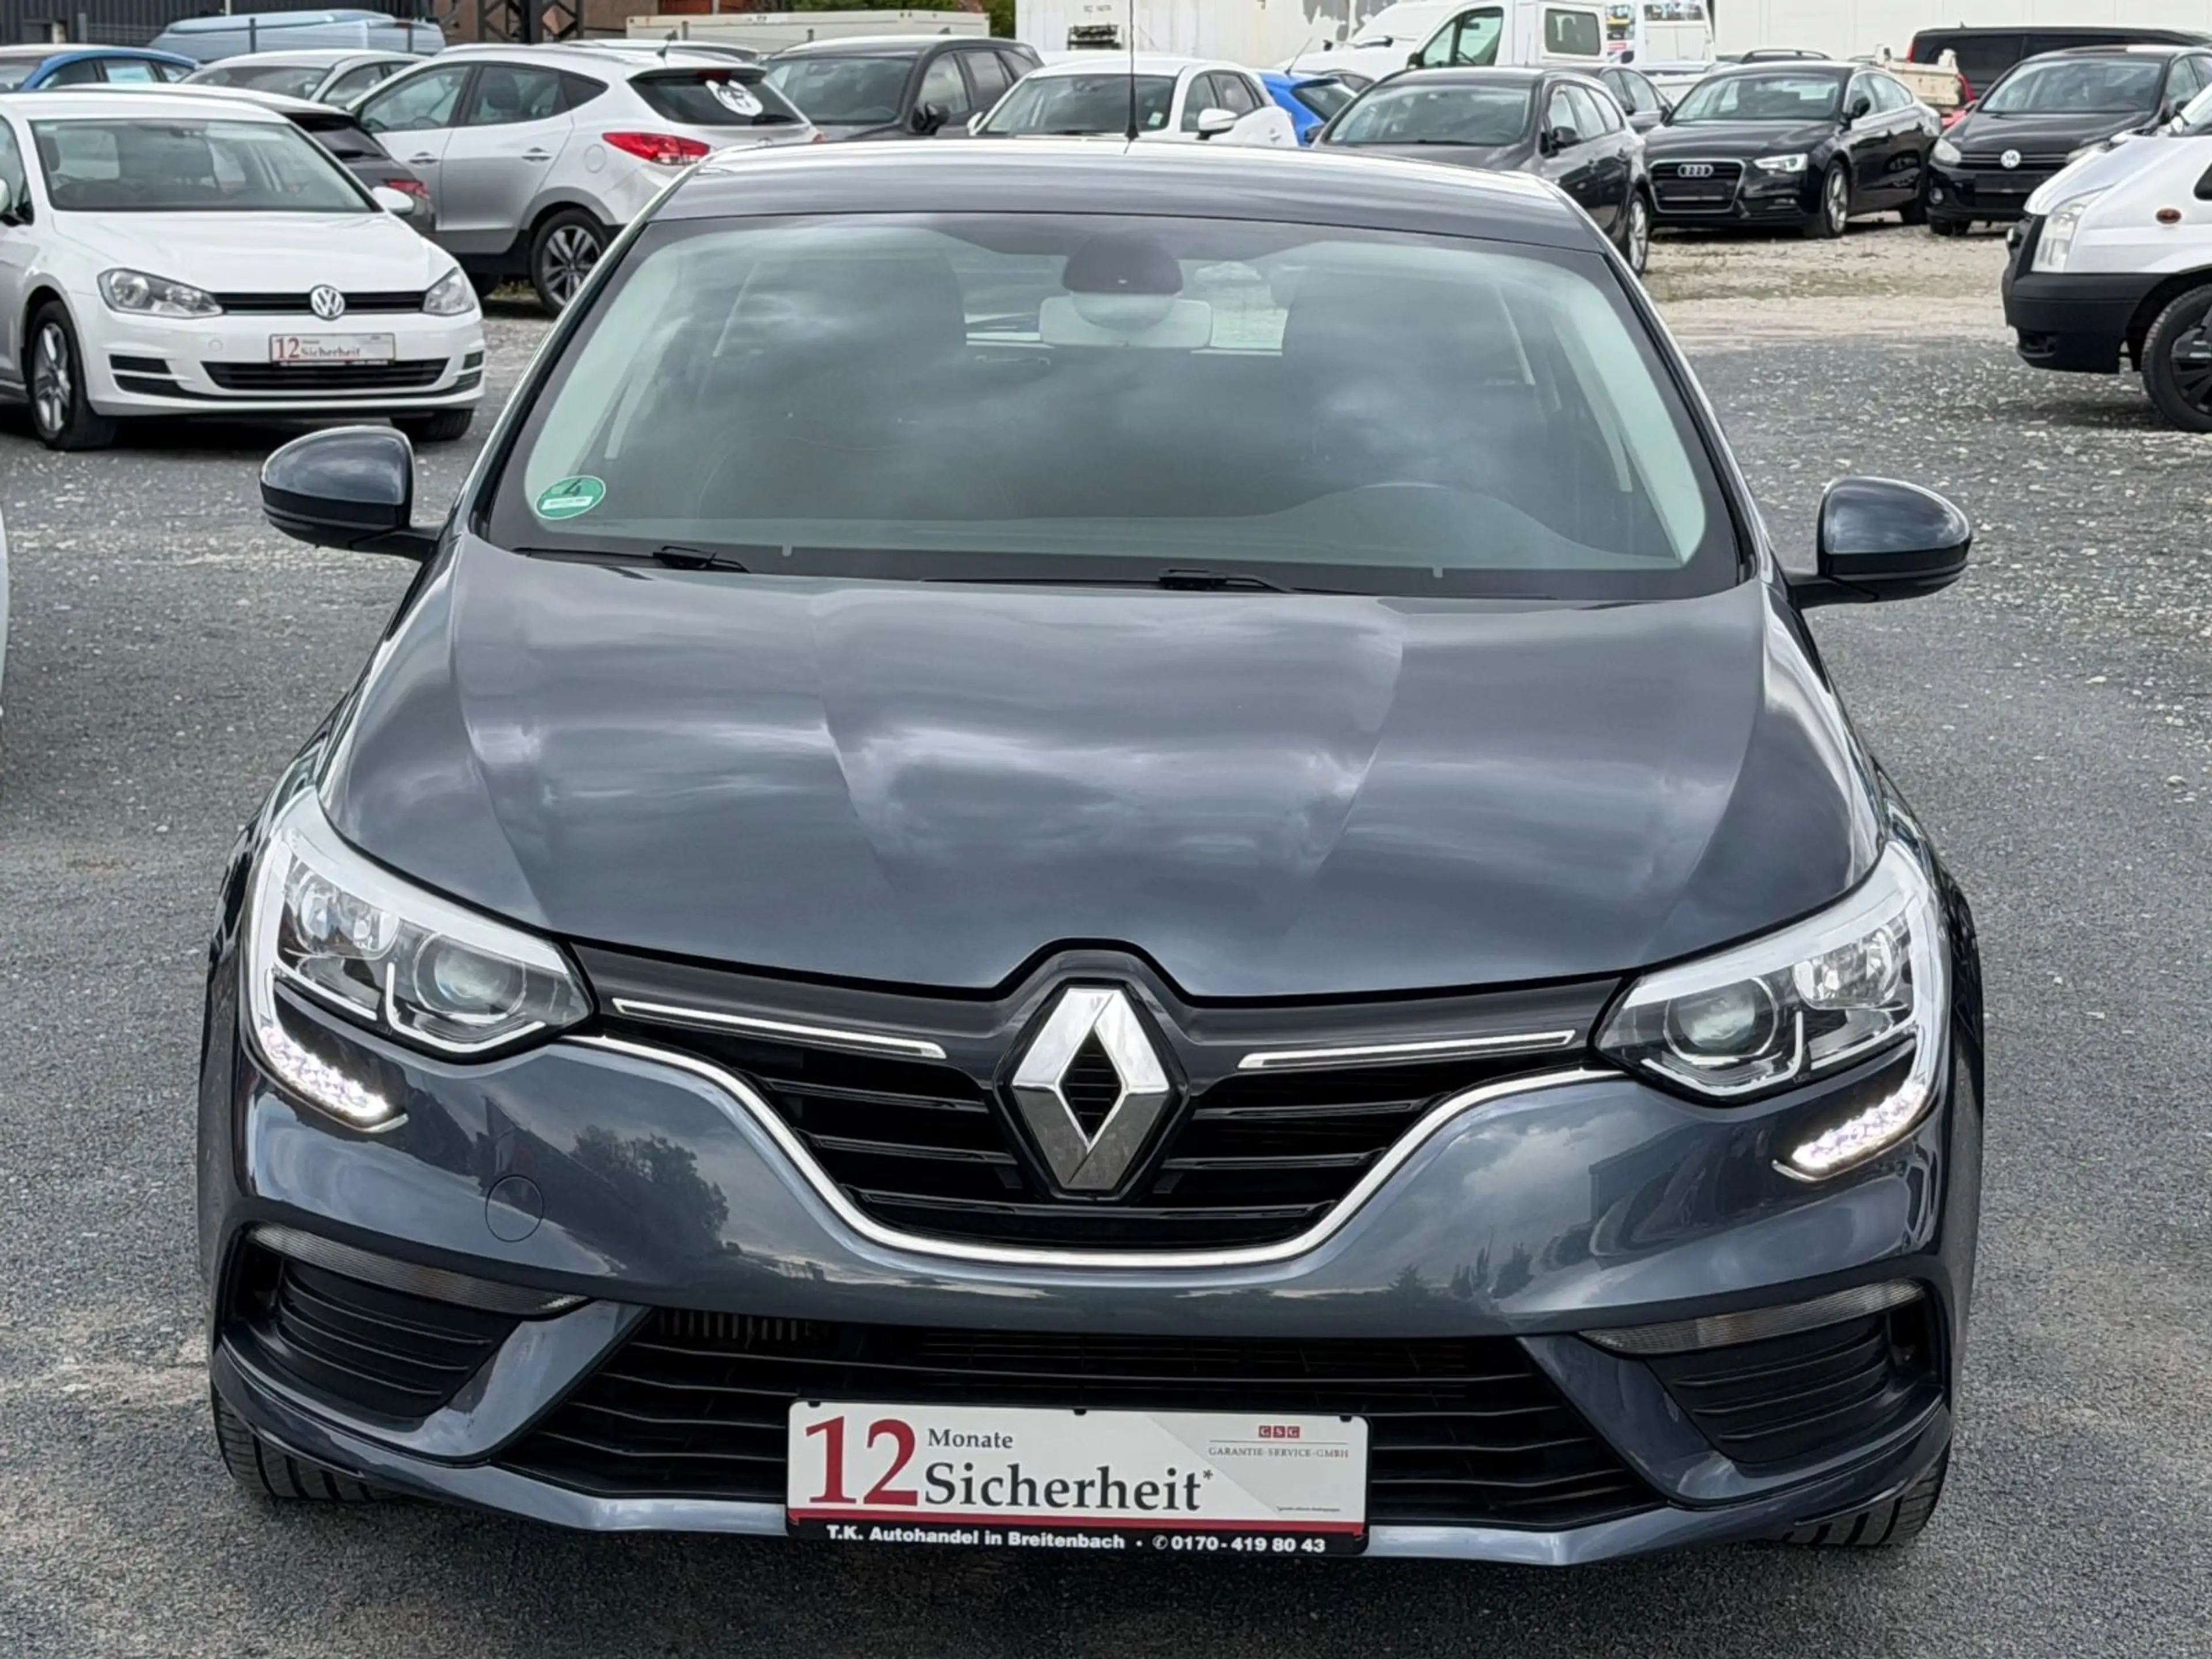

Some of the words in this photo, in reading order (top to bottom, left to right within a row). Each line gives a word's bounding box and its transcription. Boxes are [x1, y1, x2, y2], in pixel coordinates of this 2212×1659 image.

[275, 336, 300, 359] 12
[928, 1428, 1014, 1449] Monate
[805, 1415, 918, 1506] 12
[826, 1524, 863, 1540] T.K.
[869, 1526, 979, 1544] Autohandel
[984, 1531, 1002, 1545] in
[1007, 1531, 1125, 1549] Breitenbach
[1272, 1537, 1296, 1552] 80
[1301, 1538, 1326, 1553] 43
